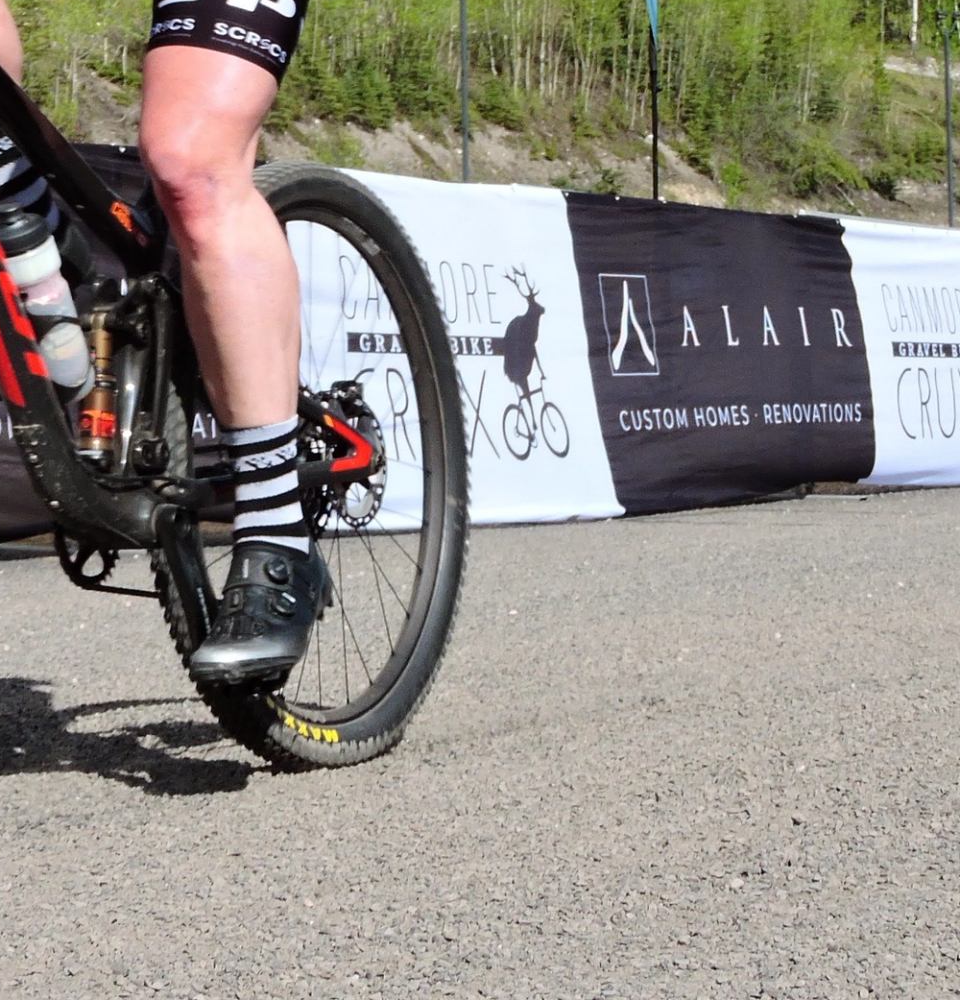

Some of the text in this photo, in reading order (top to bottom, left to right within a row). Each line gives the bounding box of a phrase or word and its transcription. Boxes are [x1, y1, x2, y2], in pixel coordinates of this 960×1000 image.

[339, 255, 501, 325] CAORE
[881, 283, 960, 335] CANMO
[681, 305, 853, 347] ALAIR
[898, 342, 946, 359] GRAVEL
[619, 402, 863, 432] CUSTOM HOMES RENOVATIONS
[896, 367, 960, 440] CRU
